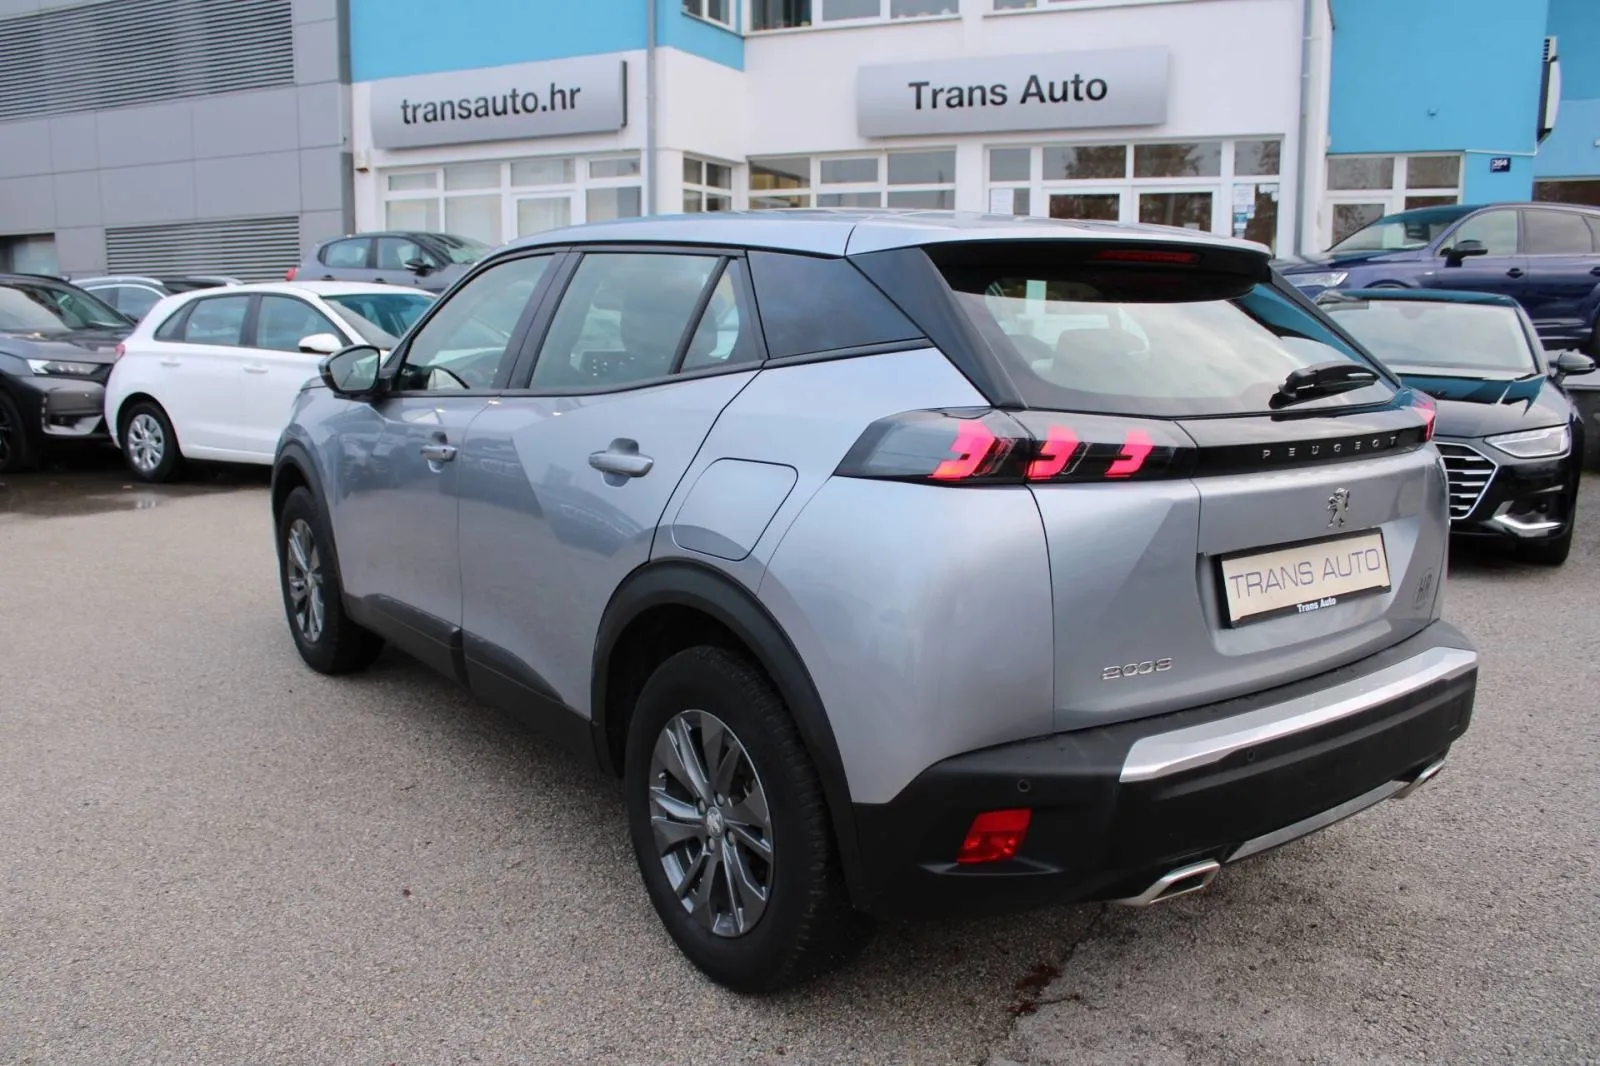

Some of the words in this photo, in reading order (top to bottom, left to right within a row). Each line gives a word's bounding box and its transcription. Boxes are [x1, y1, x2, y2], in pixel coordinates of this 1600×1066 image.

[401, 82, 581, 126] transauto.hr
[909, 80, 1008, 110] Trans
[1020, 73, 1107, 105] Auto
[1263, 435, 1396, 459] PEUGEOT
[1229, 561, 1314, 599] TRANS
[1322, 548, 1381, 581] AUTO
[1297, 602, 1319, 613] Trans
[1320, 597, 1336, 608] Auto
[1102, 657, 1172, 680] 2008
